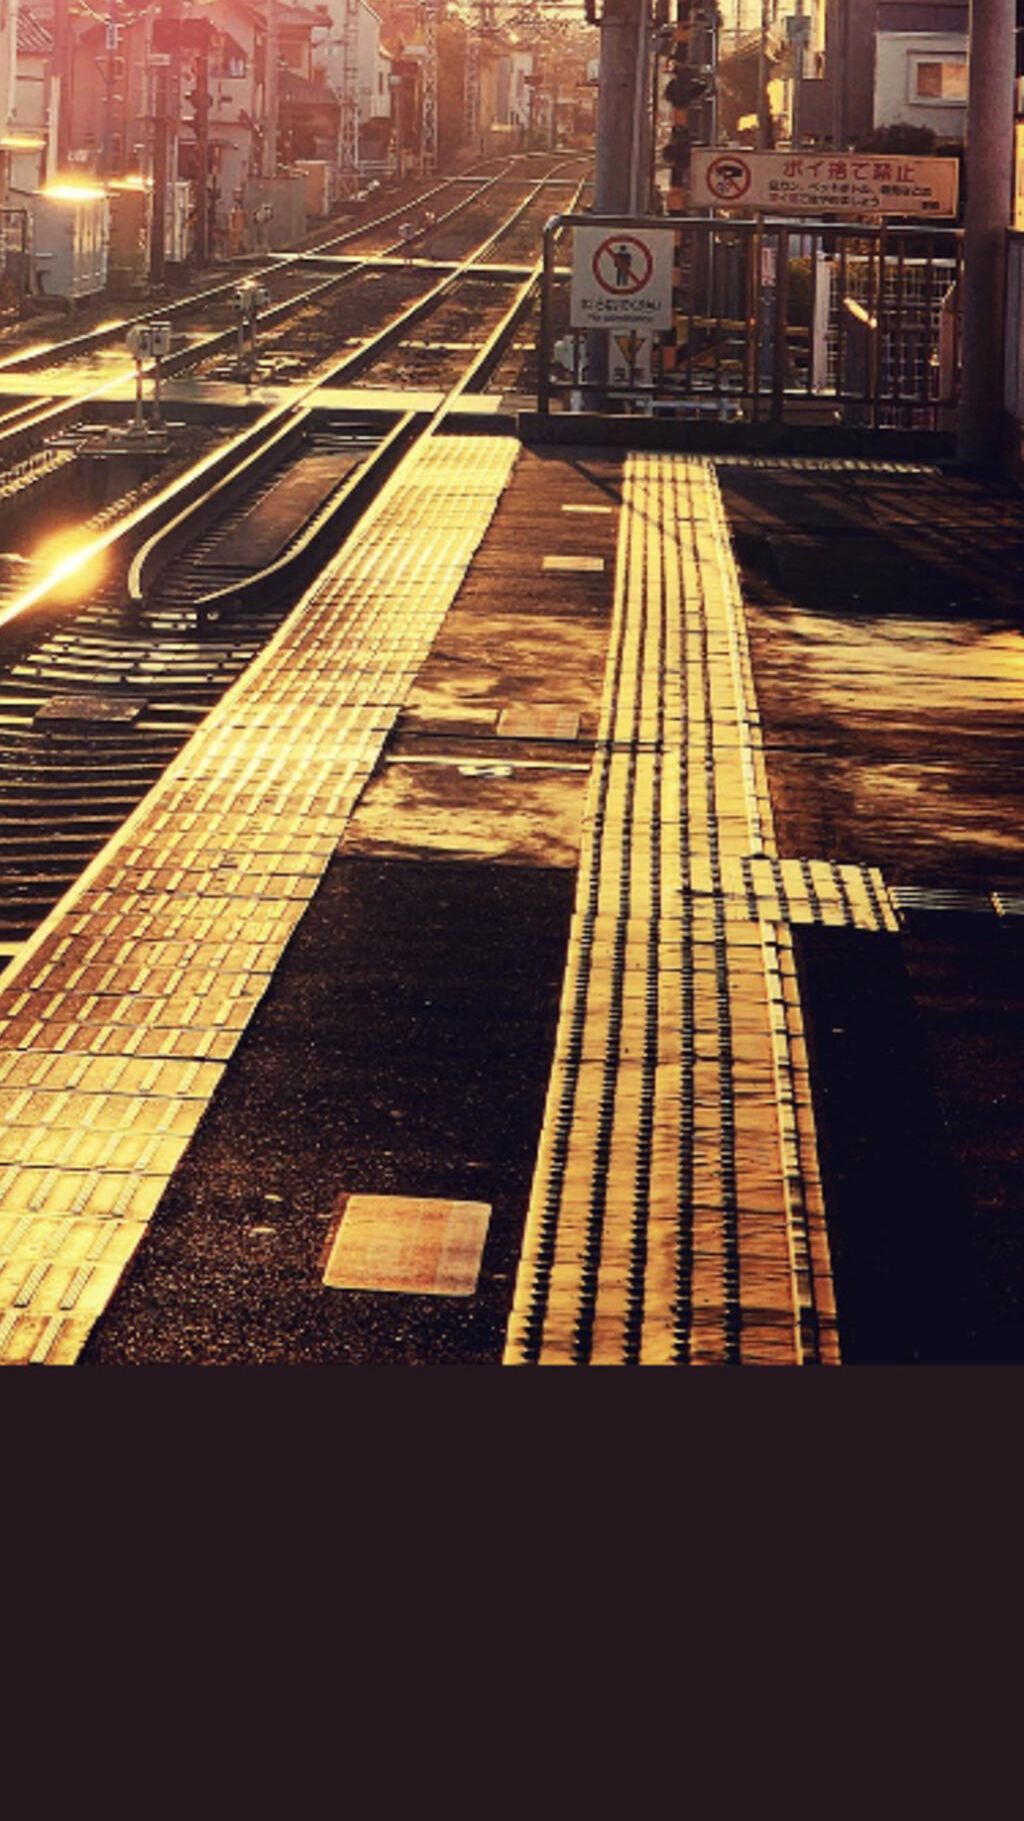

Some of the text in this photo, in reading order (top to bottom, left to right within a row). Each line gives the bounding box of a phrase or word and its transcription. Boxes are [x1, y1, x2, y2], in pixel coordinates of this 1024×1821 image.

[783, 160, 916, 183] ポイ捨て禁止
